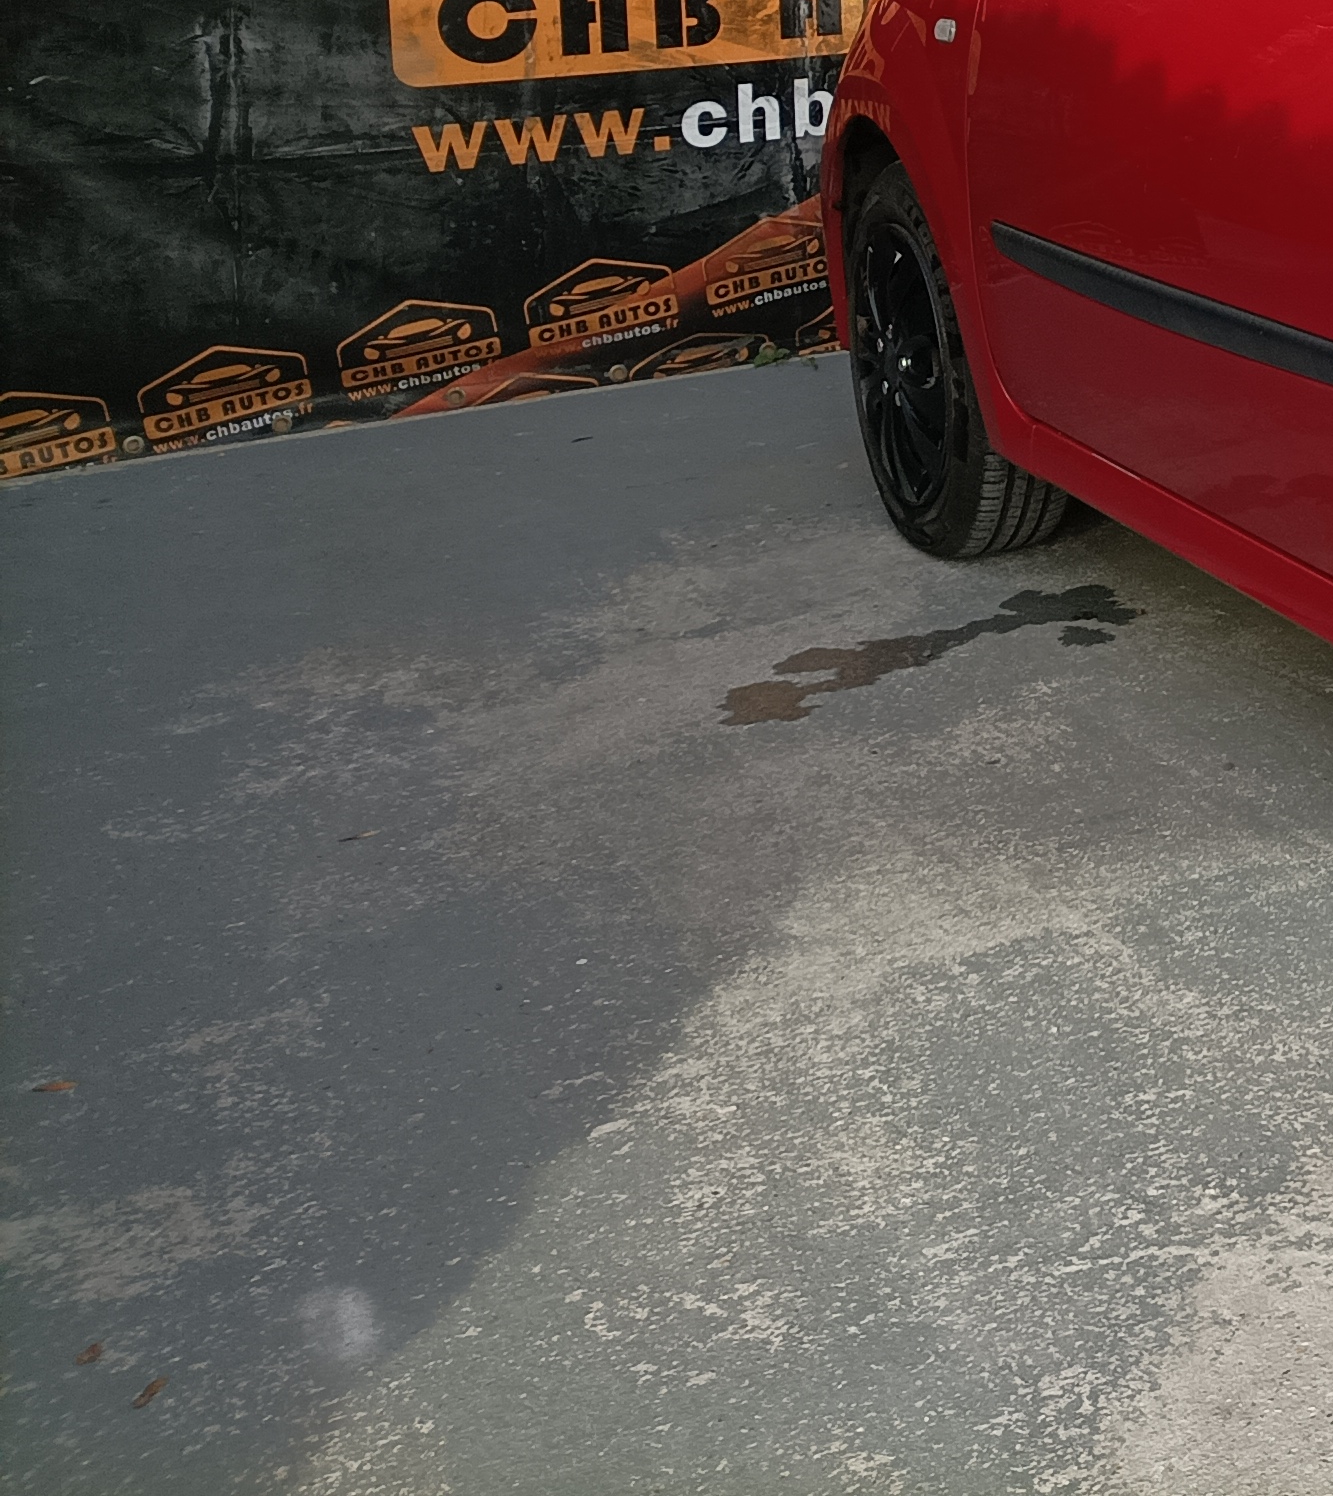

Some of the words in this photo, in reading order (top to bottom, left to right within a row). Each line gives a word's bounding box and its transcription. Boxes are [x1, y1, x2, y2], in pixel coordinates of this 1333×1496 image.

[713, 276, 761, 299] CHB
[538, 319, 589, 343] CHB
[598, 297, 673, 329] AUTOS
[350, 362, 406, 382] CHB
[415, 340, 496, 371] AUTOS
[154, 407, 211, 433] CHB
[220, 381, 305, 416] AUTOS
[19, 431, 108, 470] AUTOS
